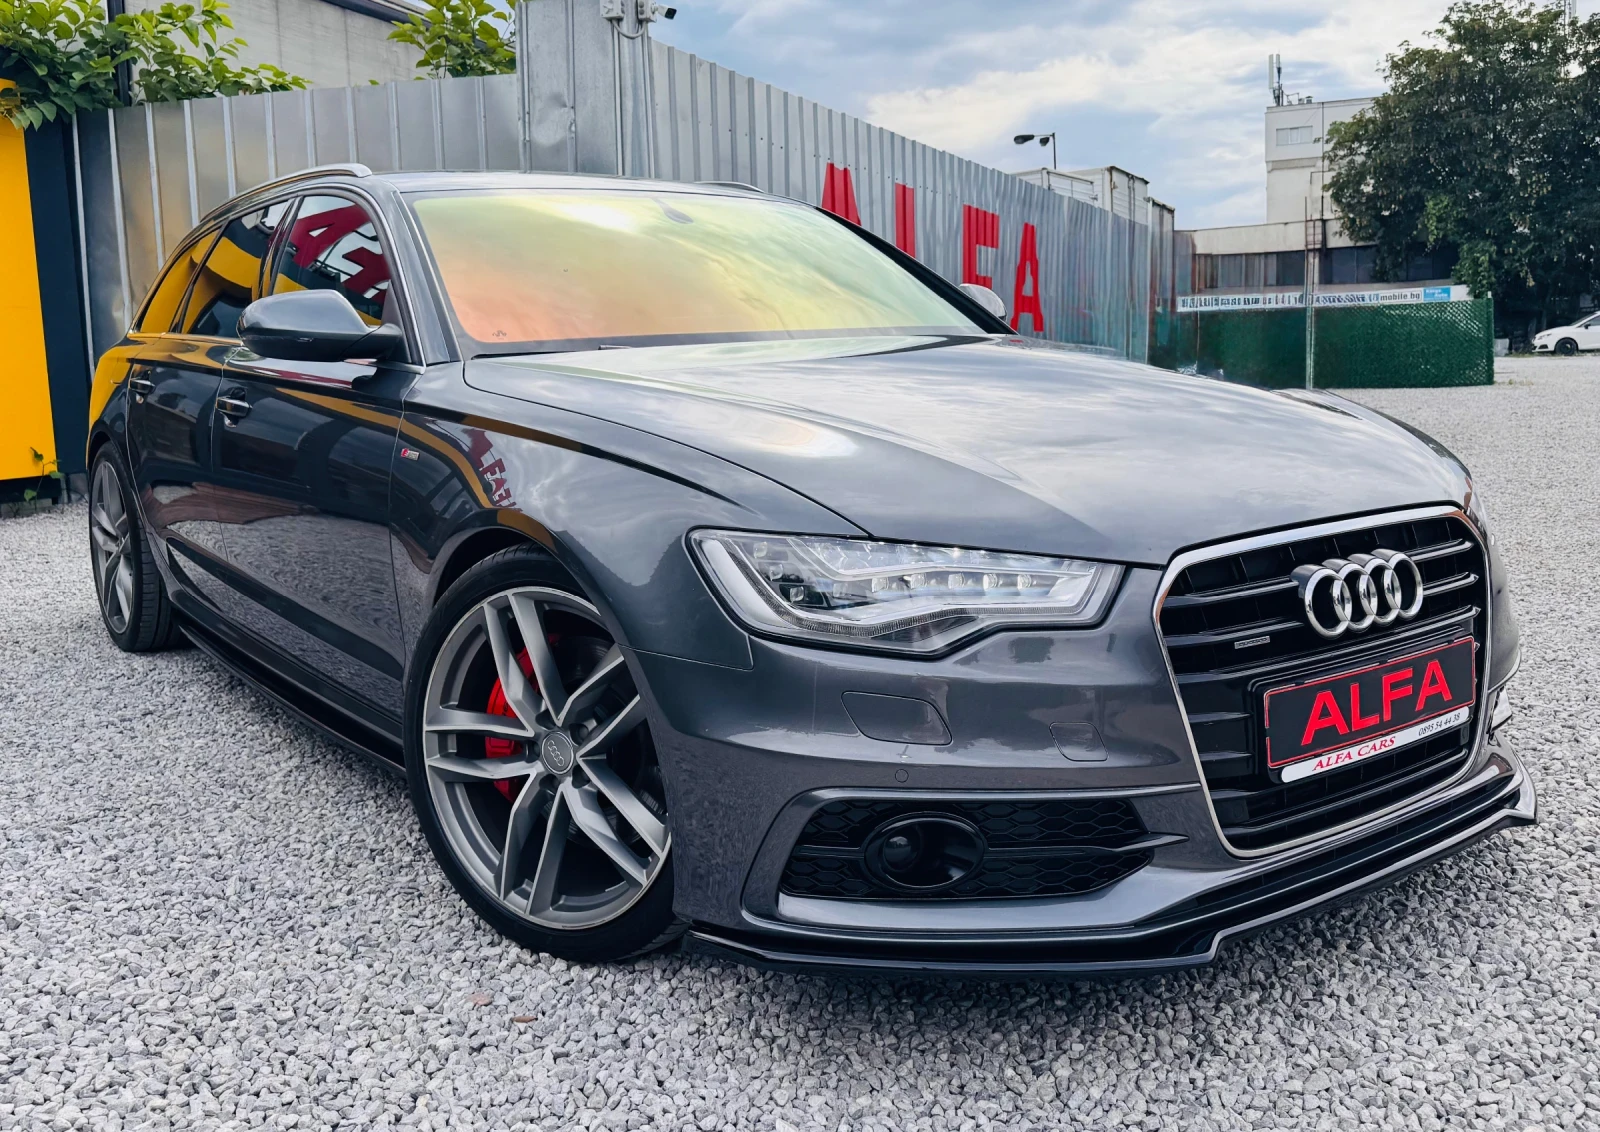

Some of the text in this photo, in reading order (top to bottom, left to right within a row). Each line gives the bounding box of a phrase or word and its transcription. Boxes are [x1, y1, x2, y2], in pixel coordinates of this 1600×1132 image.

[1301, 659, 1453, 746] ALFA
[1418, 712, 1461, 737] 0895 54 44 38
[1312, 736, 1396, 772] ALFA CARS
